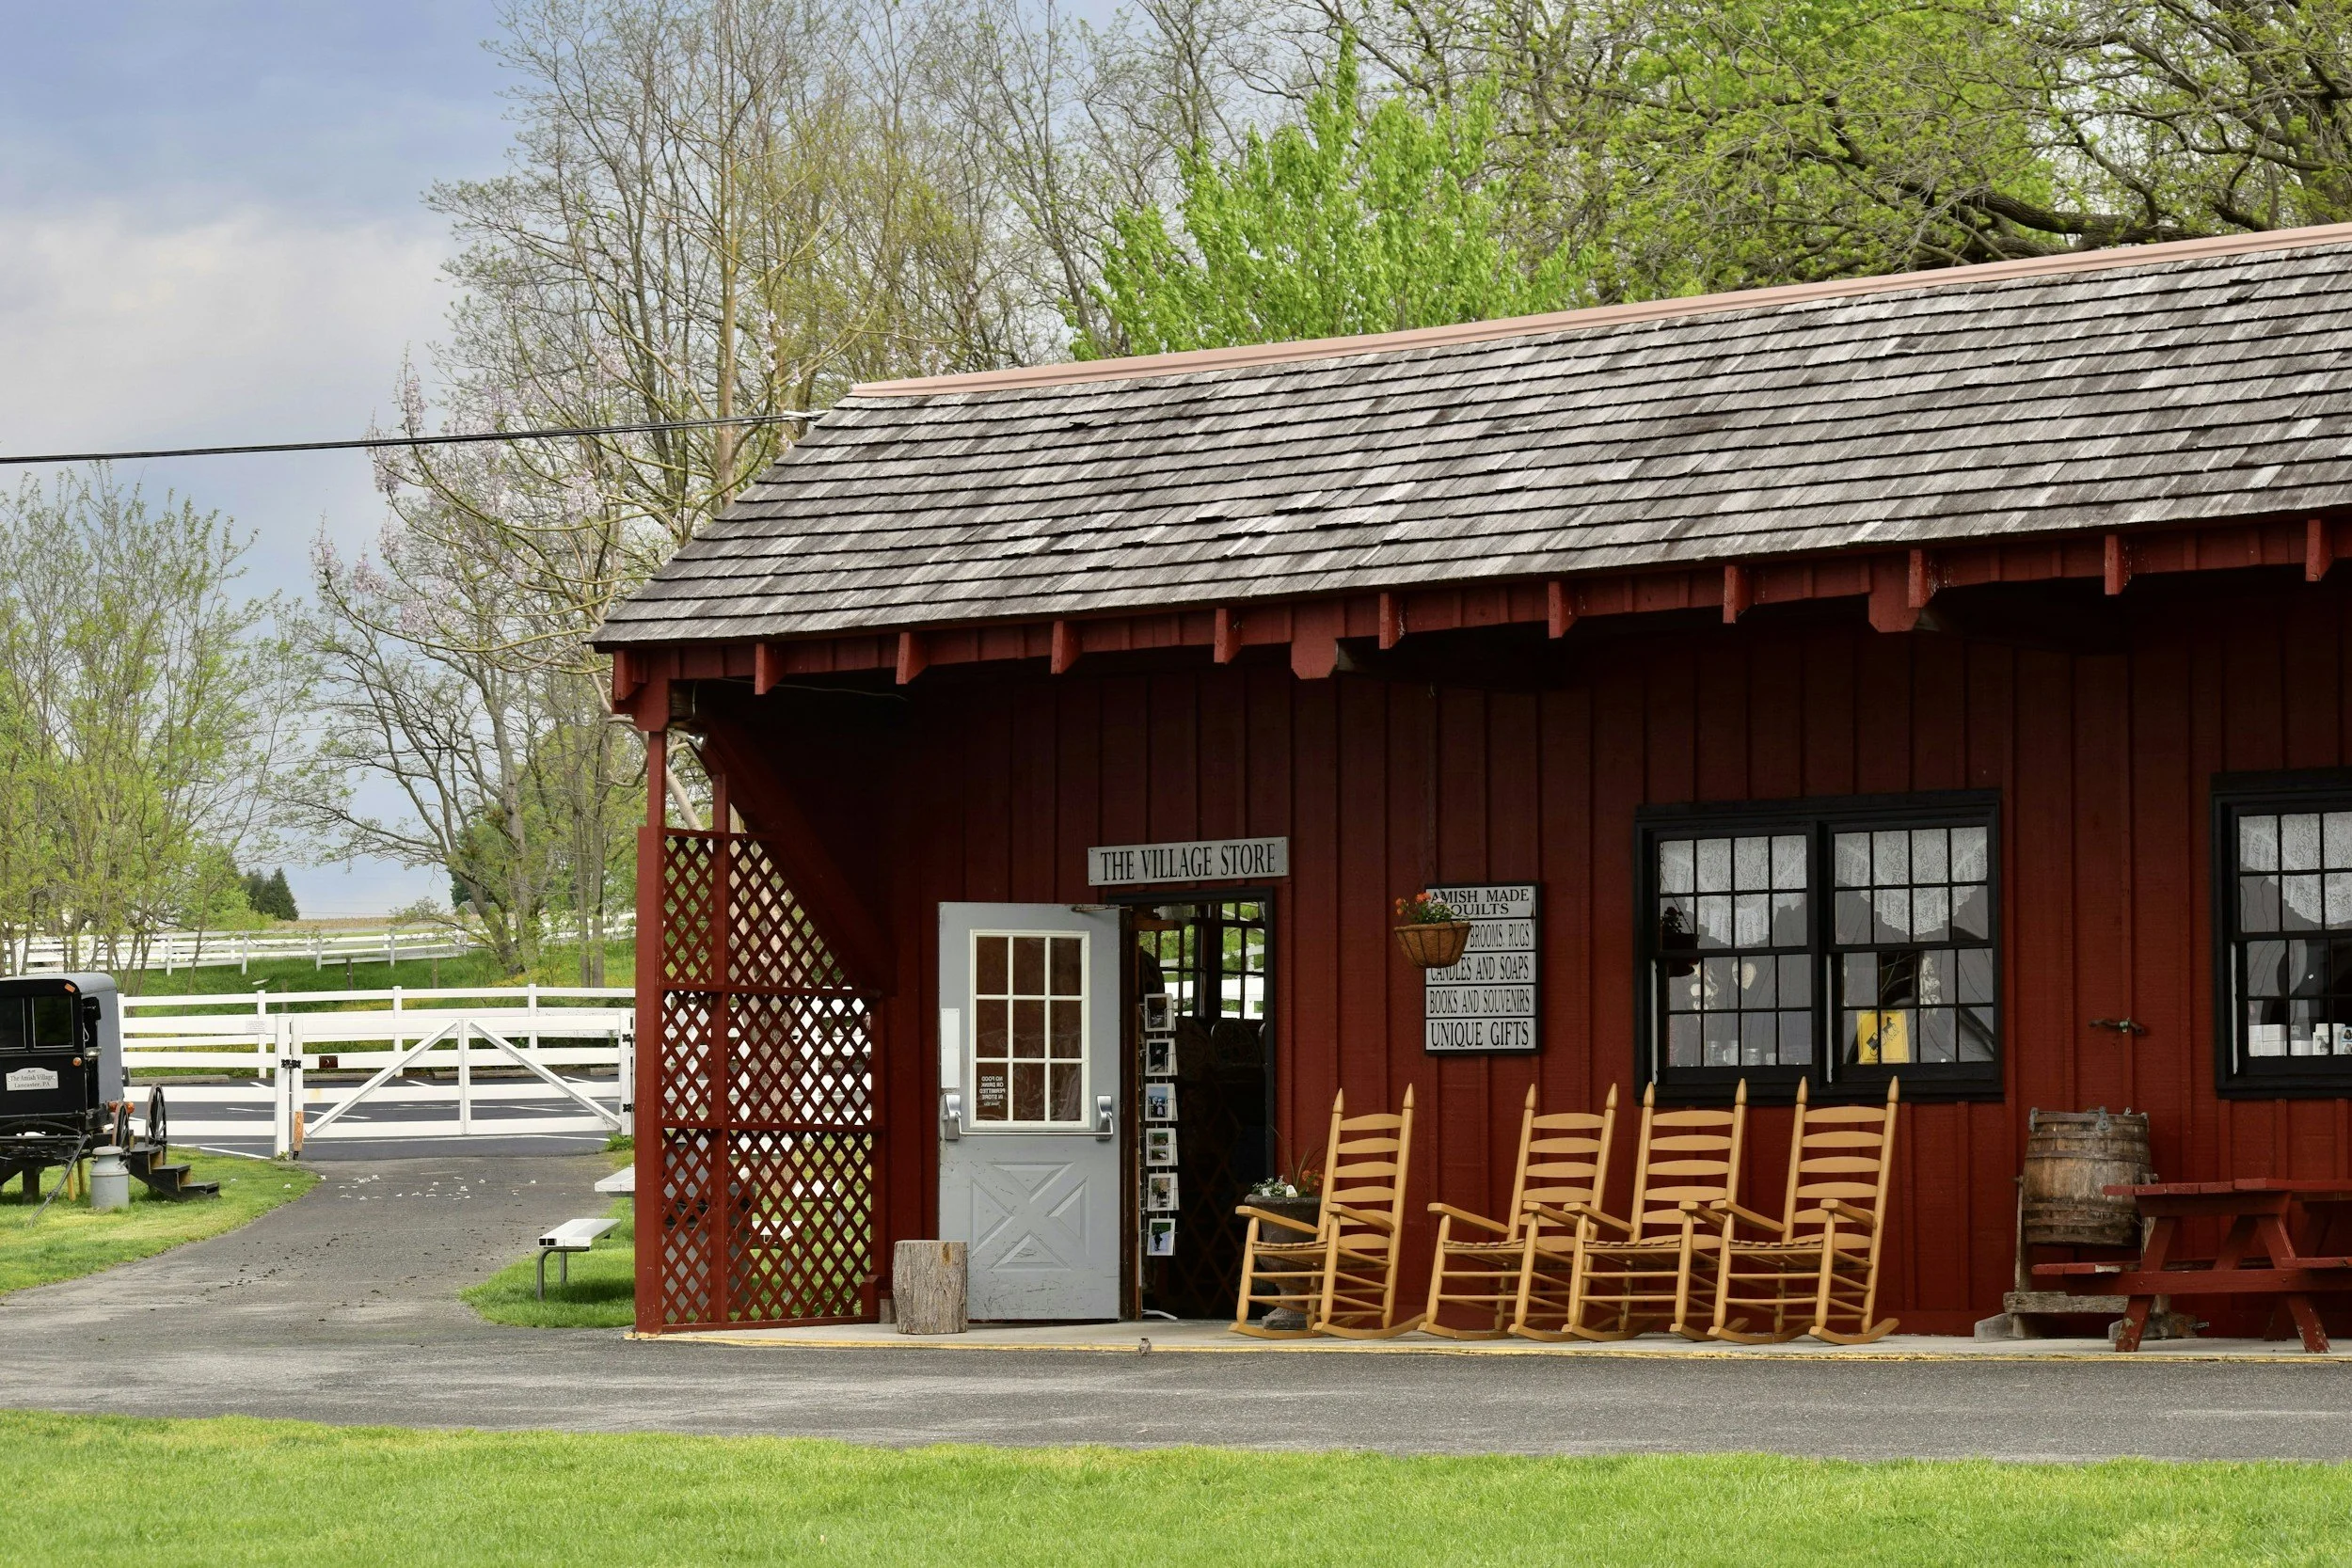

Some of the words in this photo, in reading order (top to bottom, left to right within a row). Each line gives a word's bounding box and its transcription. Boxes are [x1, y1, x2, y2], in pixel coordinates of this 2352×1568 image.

[1100, 850, 1135, 881] THE
[1140, 847, 1213, 879] VILLAGE
[1220, 843, 1276, 877] STORE
[1430, 890, 1478, 904] AMISH
[1486, 889, 1530, 903] MADE
[1450, 903, 1509, 916] QUILTS
[1508, 923, 1530, 947] RUGS
[1476, 957, 1496, 981] AND
[1500, 956, 1529, 980] SOAPS
[1429, 990, 1458, 1014] BOOKS
[1462, 990, 1480, 1013] AND
[1484, 989, 1530, 1013] SOUVENIRS
[1431, 1022, 1484, 1047] UNIQUE
[1490, 1022, 1529, 1046] GIFTS
